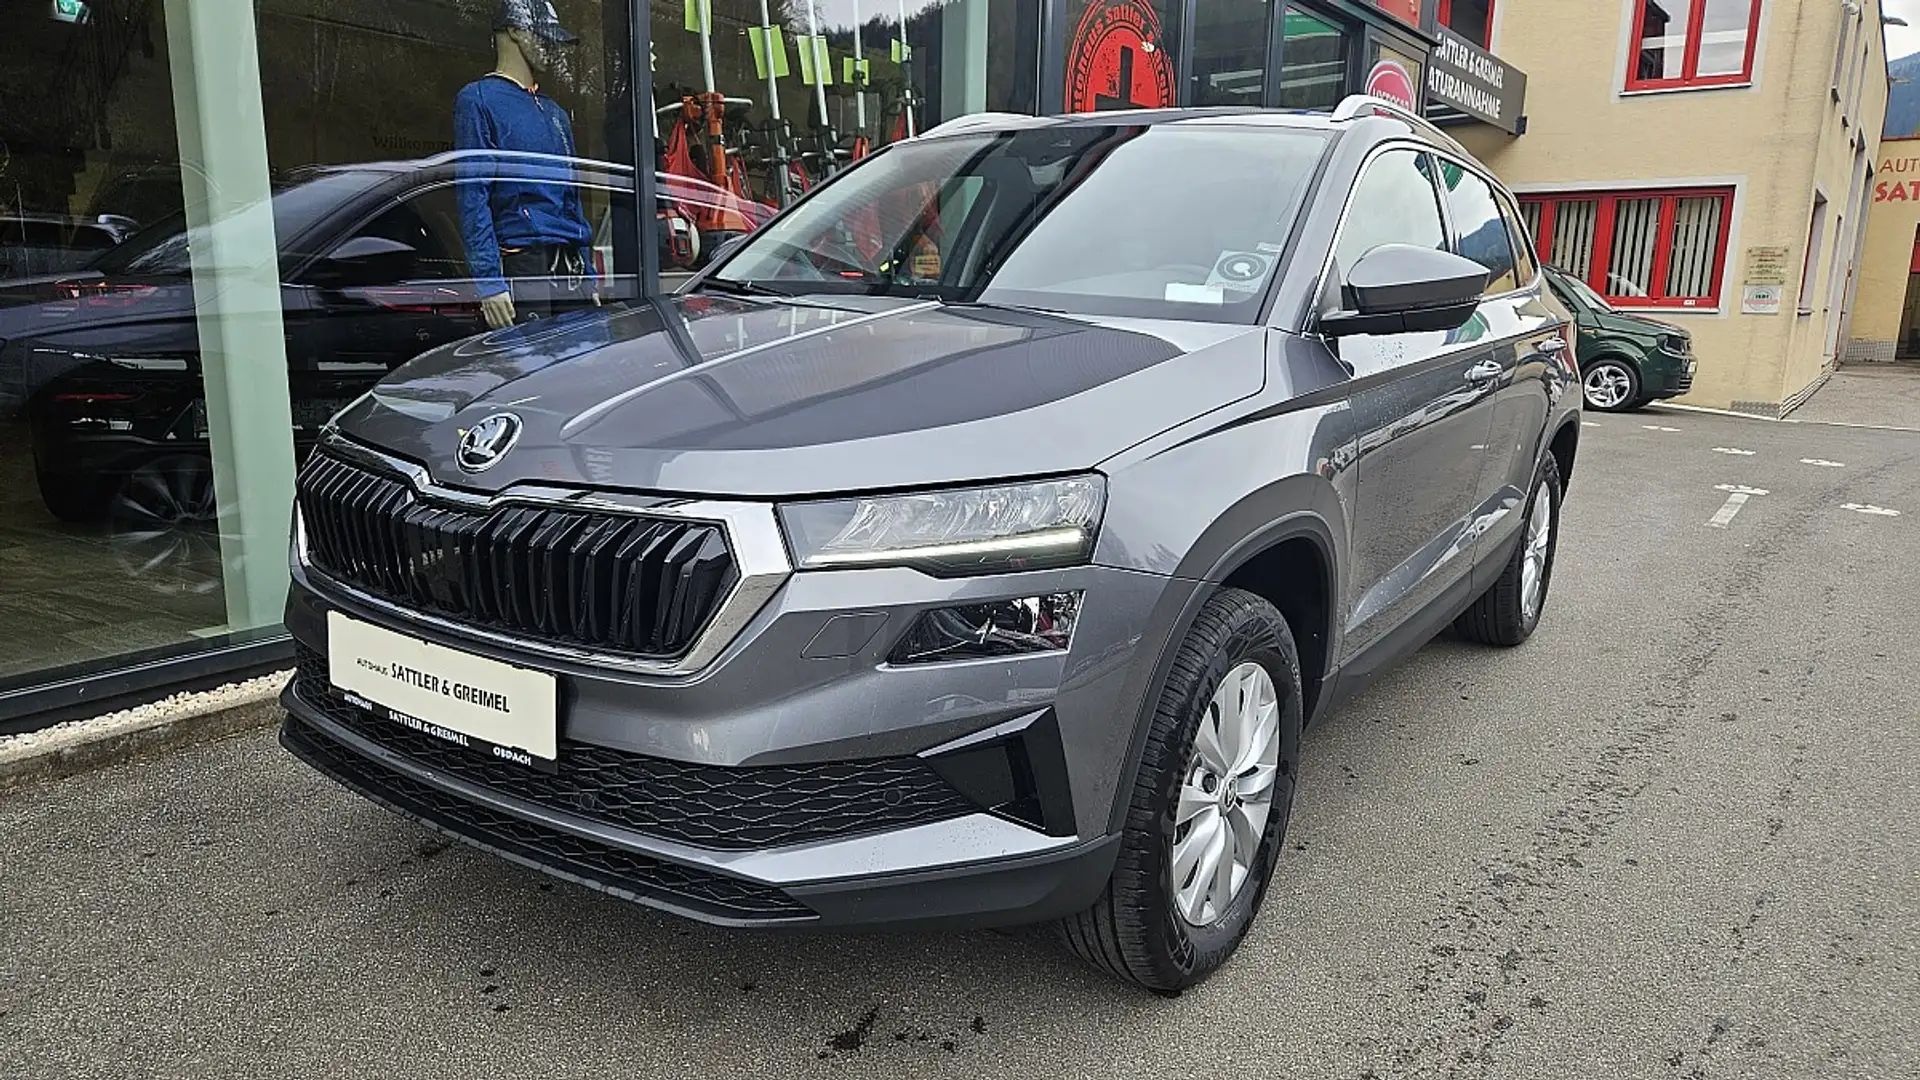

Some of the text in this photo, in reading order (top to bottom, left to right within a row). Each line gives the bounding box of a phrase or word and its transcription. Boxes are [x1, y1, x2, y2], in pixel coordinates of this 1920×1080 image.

[1074, 18, 1103, 112] utohaus
[1105, 4, 1146, 30] Sattler
[1428, 66, 1501, 119] ATURANNAHME
[1875, 181, 1920, 202] SAT
[1879, 158, 1920, 173] AUT
[356, 657, 510, 713] AUTOHAUS SATTLER & GREIMEL
[389, 710, 422, 730] SATTLER
[423, 723, 430, 733] &
[430, 726, 469, 746] GREIMEL
[493, 747, 532, 766] OBDACH
